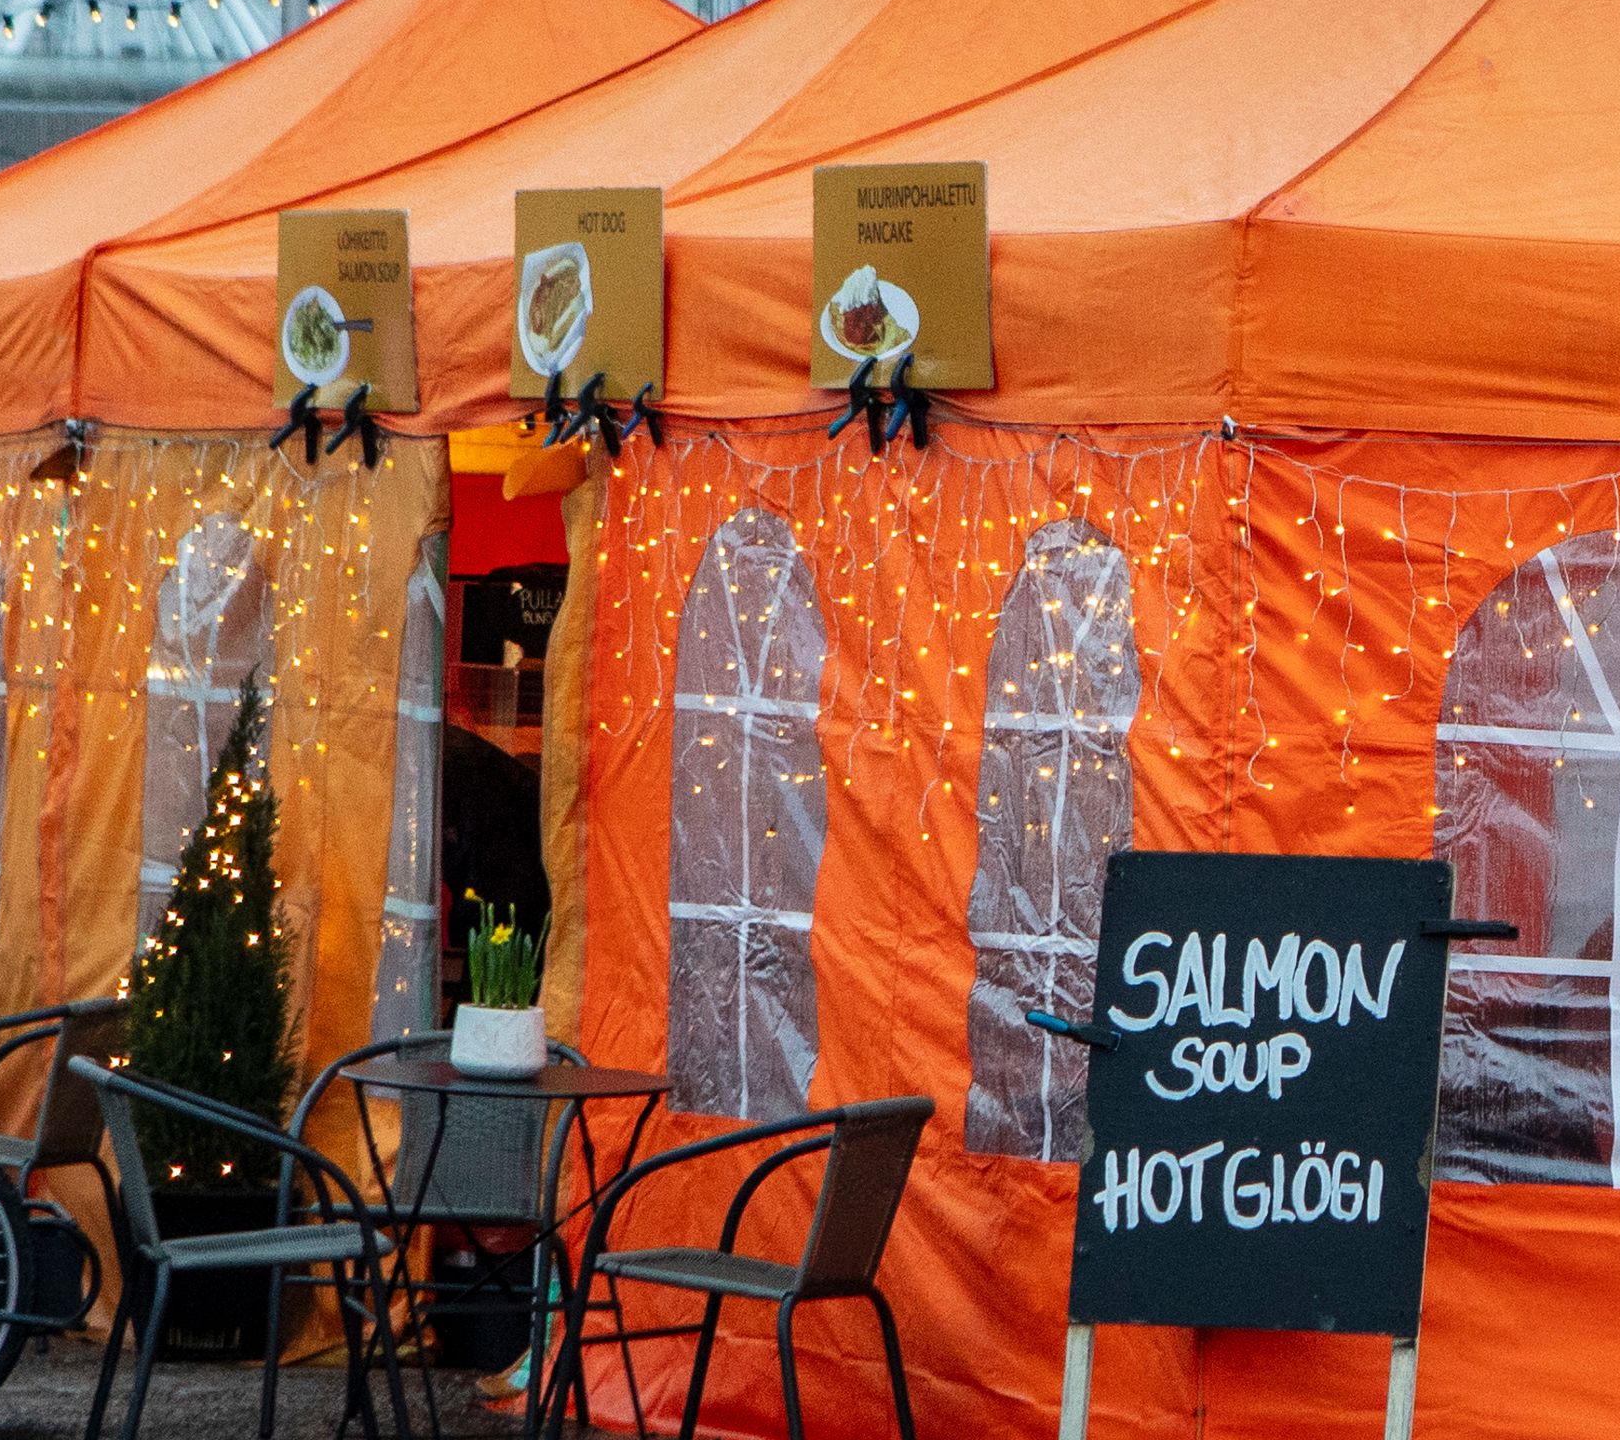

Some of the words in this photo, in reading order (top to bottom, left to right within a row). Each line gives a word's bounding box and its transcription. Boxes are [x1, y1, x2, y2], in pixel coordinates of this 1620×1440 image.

[857, 183, 977, 209] MUURINPOHJALETTU
[578, 212, 599, 233] HOT
[601, 211, 626, 233] DOG
[857, 221, 914, 244] PANCAKE
[1106, 931, 1406, 1032] SALMON
[1145, 1032, 1311, 1100] SOUP
[1093, 1141, 1225, 1233] HOT
[1223, 1142, 1384, 1229] GLÖGI
